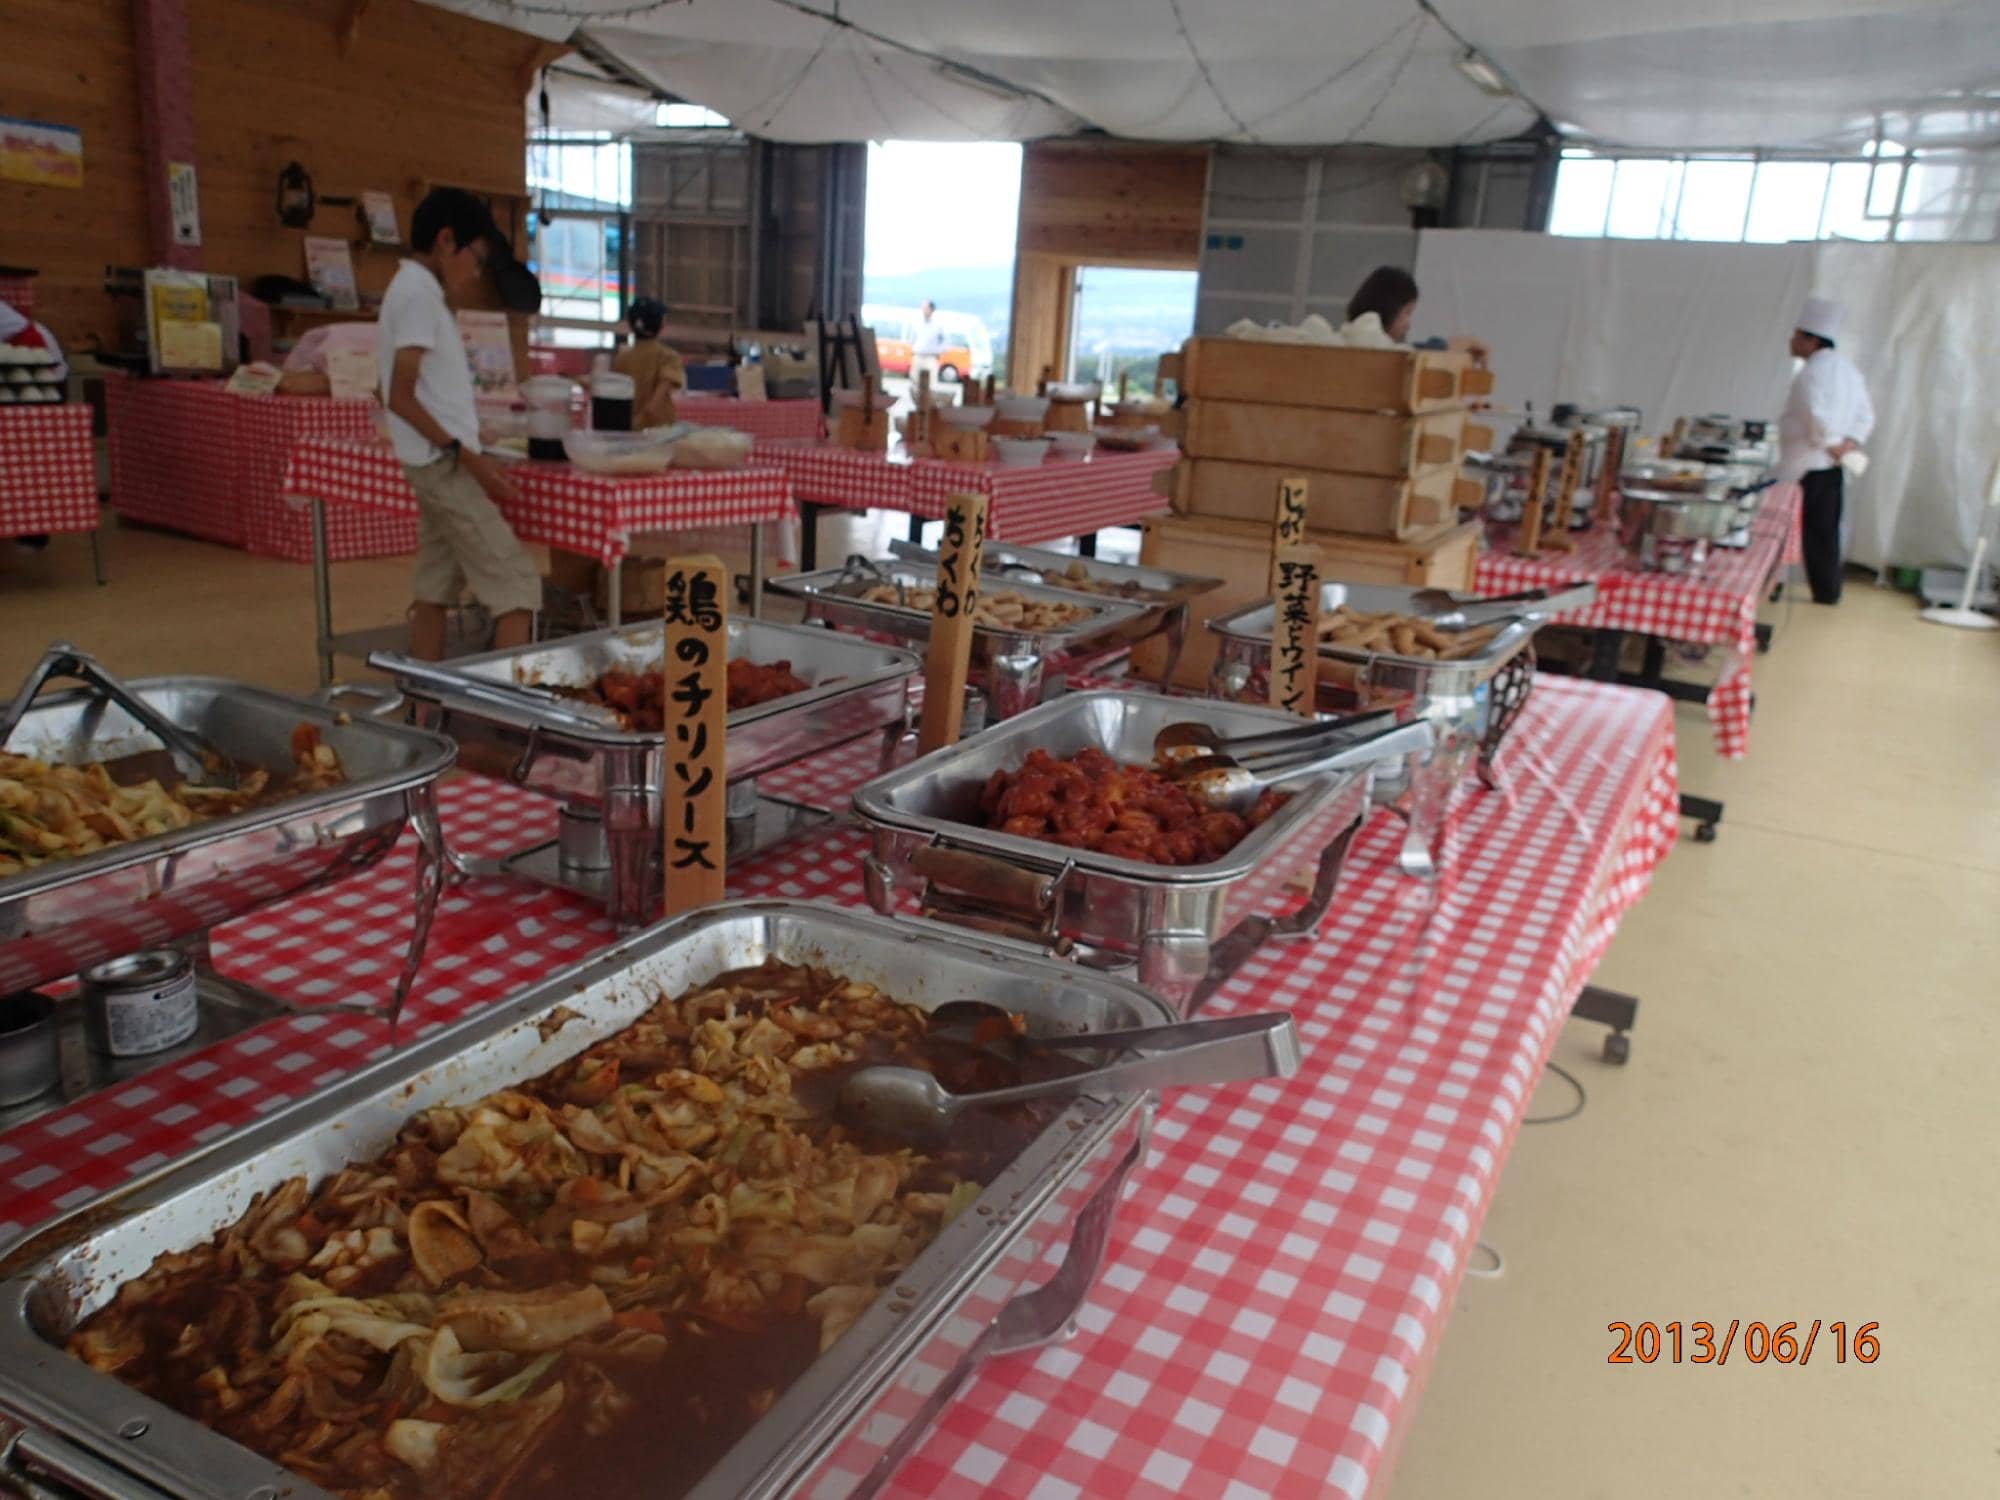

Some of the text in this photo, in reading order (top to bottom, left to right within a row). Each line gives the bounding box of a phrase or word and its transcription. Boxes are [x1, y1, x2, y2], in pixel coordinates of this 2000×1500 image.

[936, 506, 966, 618] ちくわ
[1278, 561, 1319, 717] 野菜とウイン
[665, 570, 723, 871] 鶏のチリソース
